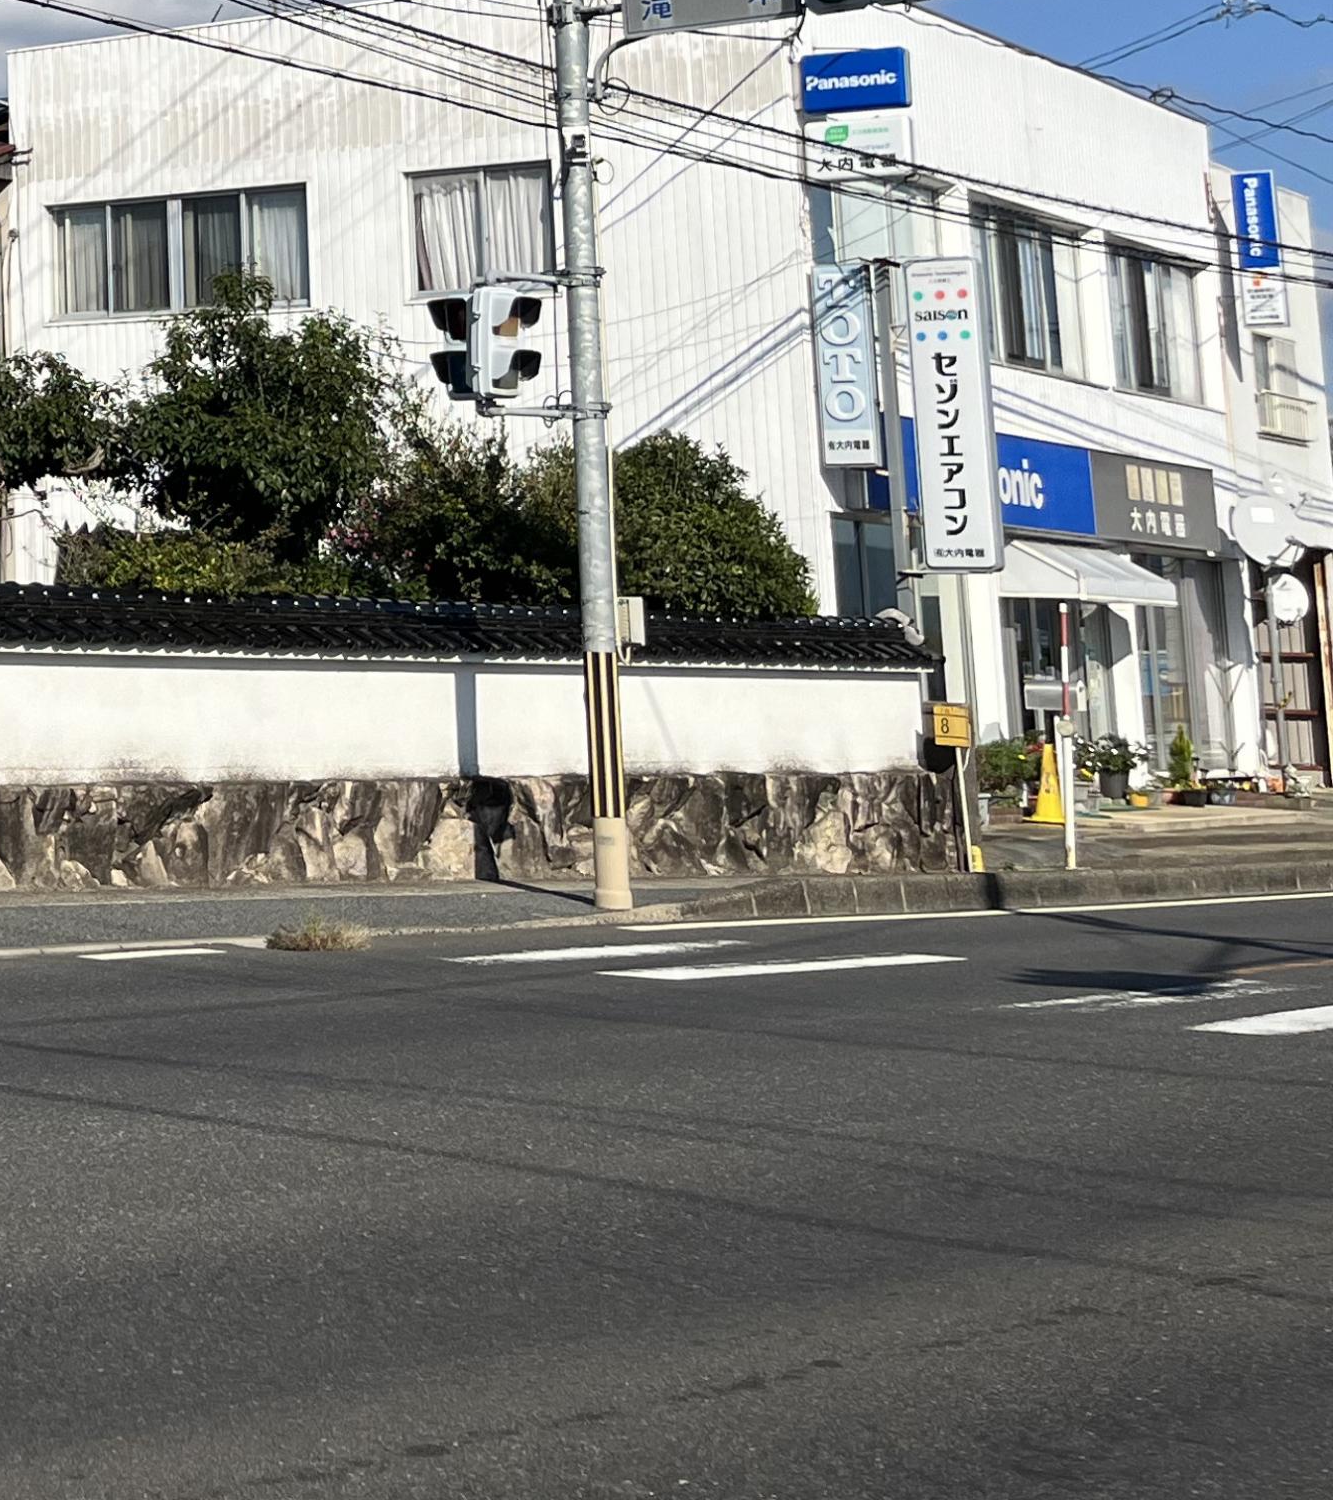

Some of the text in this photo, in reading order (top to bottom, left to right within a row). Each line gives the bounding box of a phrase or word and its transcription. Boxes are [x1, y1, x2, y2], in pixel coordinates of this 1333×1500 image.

[805, 69, 897, 91] Panasonic
[914, 308, 969, 322] saison
[816, 272, 866, 422] TOTO
[931, 352, 968, 536] セゾンエアコン
[1129, 506, 1187, 538] 大内電器
[941, 717, 950, 734] 8
